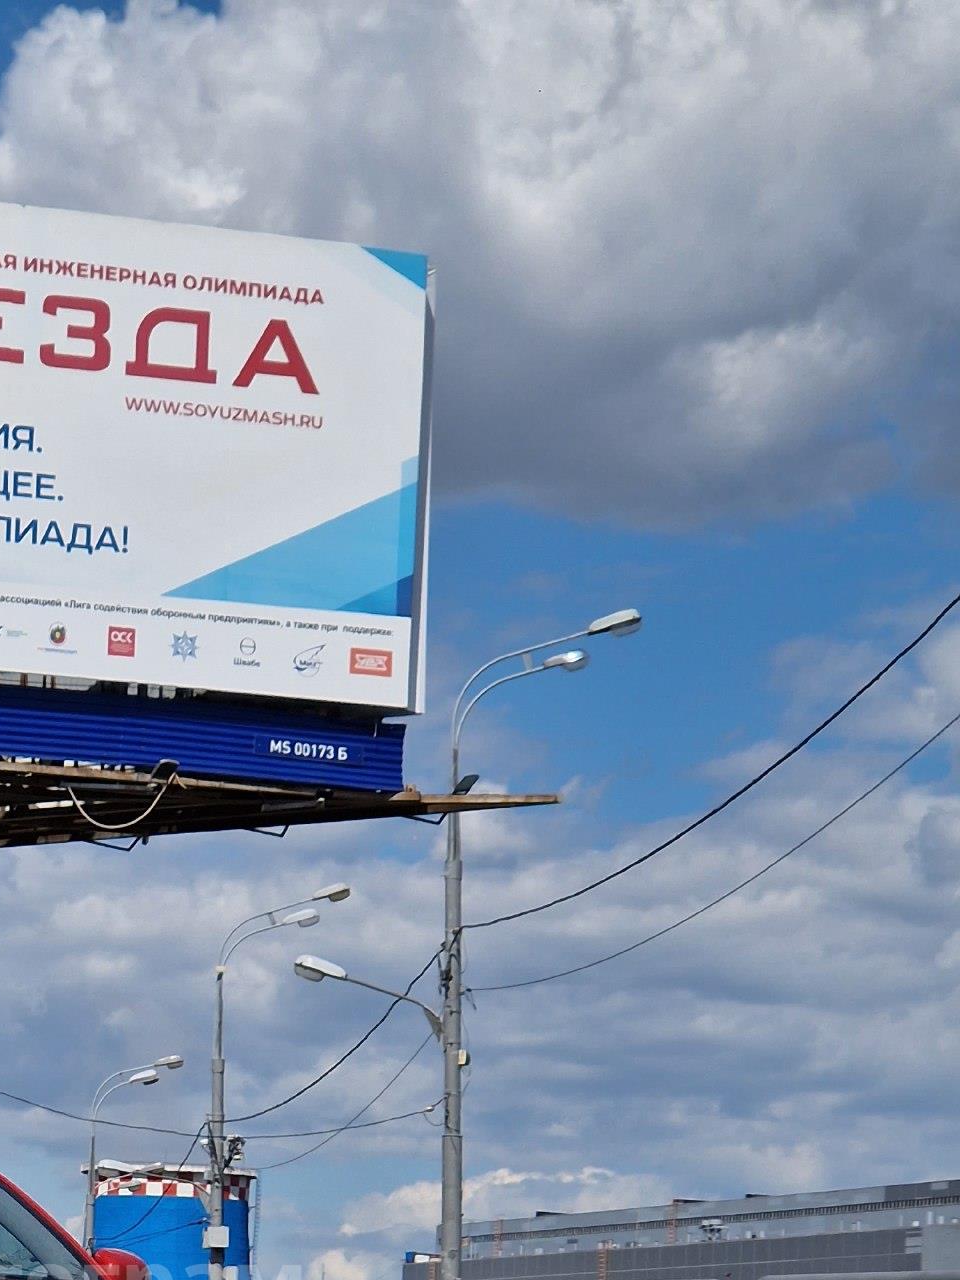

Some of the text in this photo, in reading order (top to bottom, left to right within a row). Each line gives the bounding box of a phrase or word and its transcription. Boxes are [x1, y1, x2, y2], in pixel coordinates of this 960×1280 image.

[23, 255, 177, 289] ИНЖЕНЕРНАЯ
[183, 274, 325, 305] ОЛИМПИАДА
[125, 396, 323, 430] WWW.SOYUZMASH.RU
[0, 595, 62, 608] ассоциацией
[64, 599, 91, 611] «Лига
[93, 604, 148, 615] содействия
[150, 608, 206, 620] оборонным
[293, 621, 320, 631] также
[321, 623, 338, 633] при
[269, 739, 291, 754] MS
[294, 742, 335, 760] 00173
